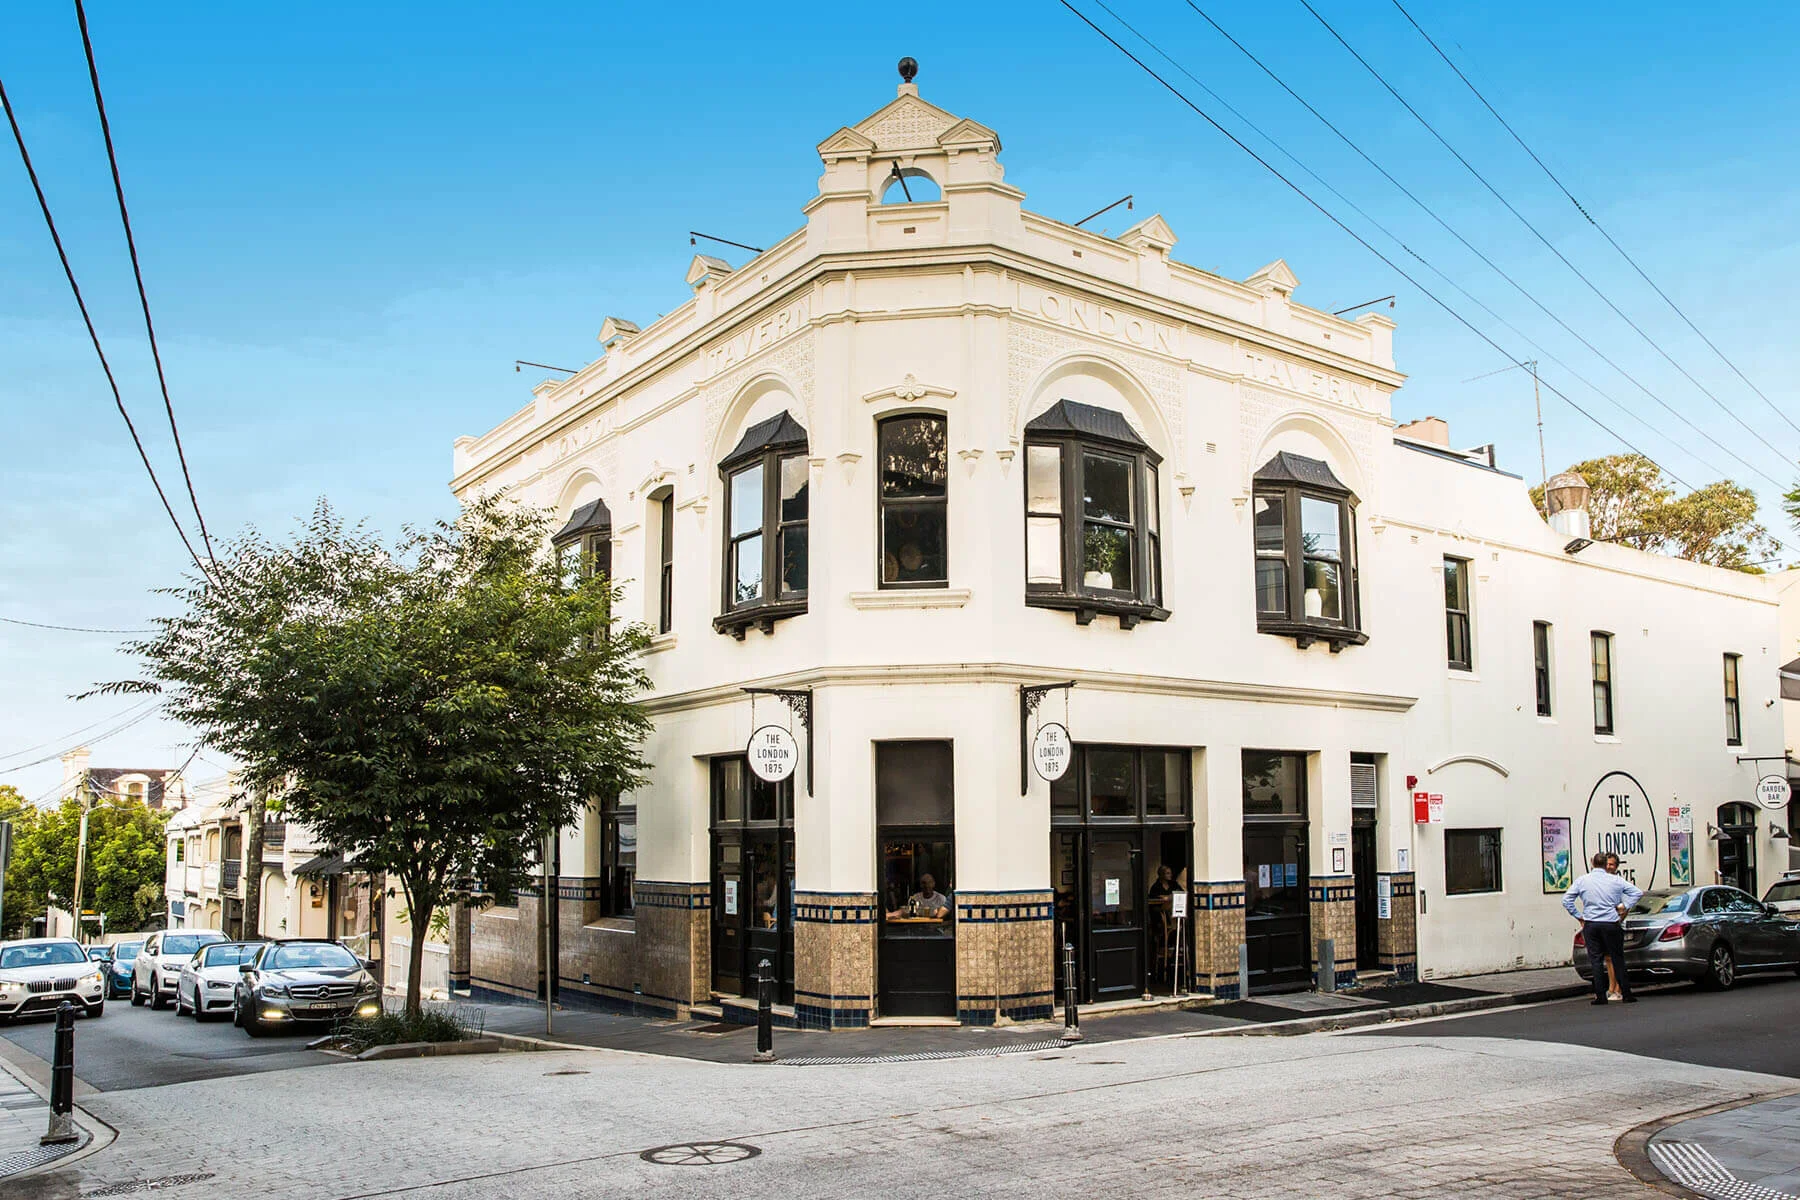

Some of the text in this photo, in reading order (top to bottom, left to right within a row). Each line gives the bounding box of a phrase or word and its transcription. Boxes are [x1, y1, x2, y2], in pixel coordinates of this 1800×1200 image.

[1016, 283, 1365, 409] LONDON TAVERN
[766, 734, 780, 744] THE
[1046, 731, 1057, 742] THE
[757, 748, 789, 759] LONDON
[1039, 747, 1064, 757] LONDON
[764, 763, 782, 773] 1875
[1045, 761, 1059, 772] 1875
[1608, 795, 1631, 817] THE
[1598, 832, 1644, 855] LONDON
